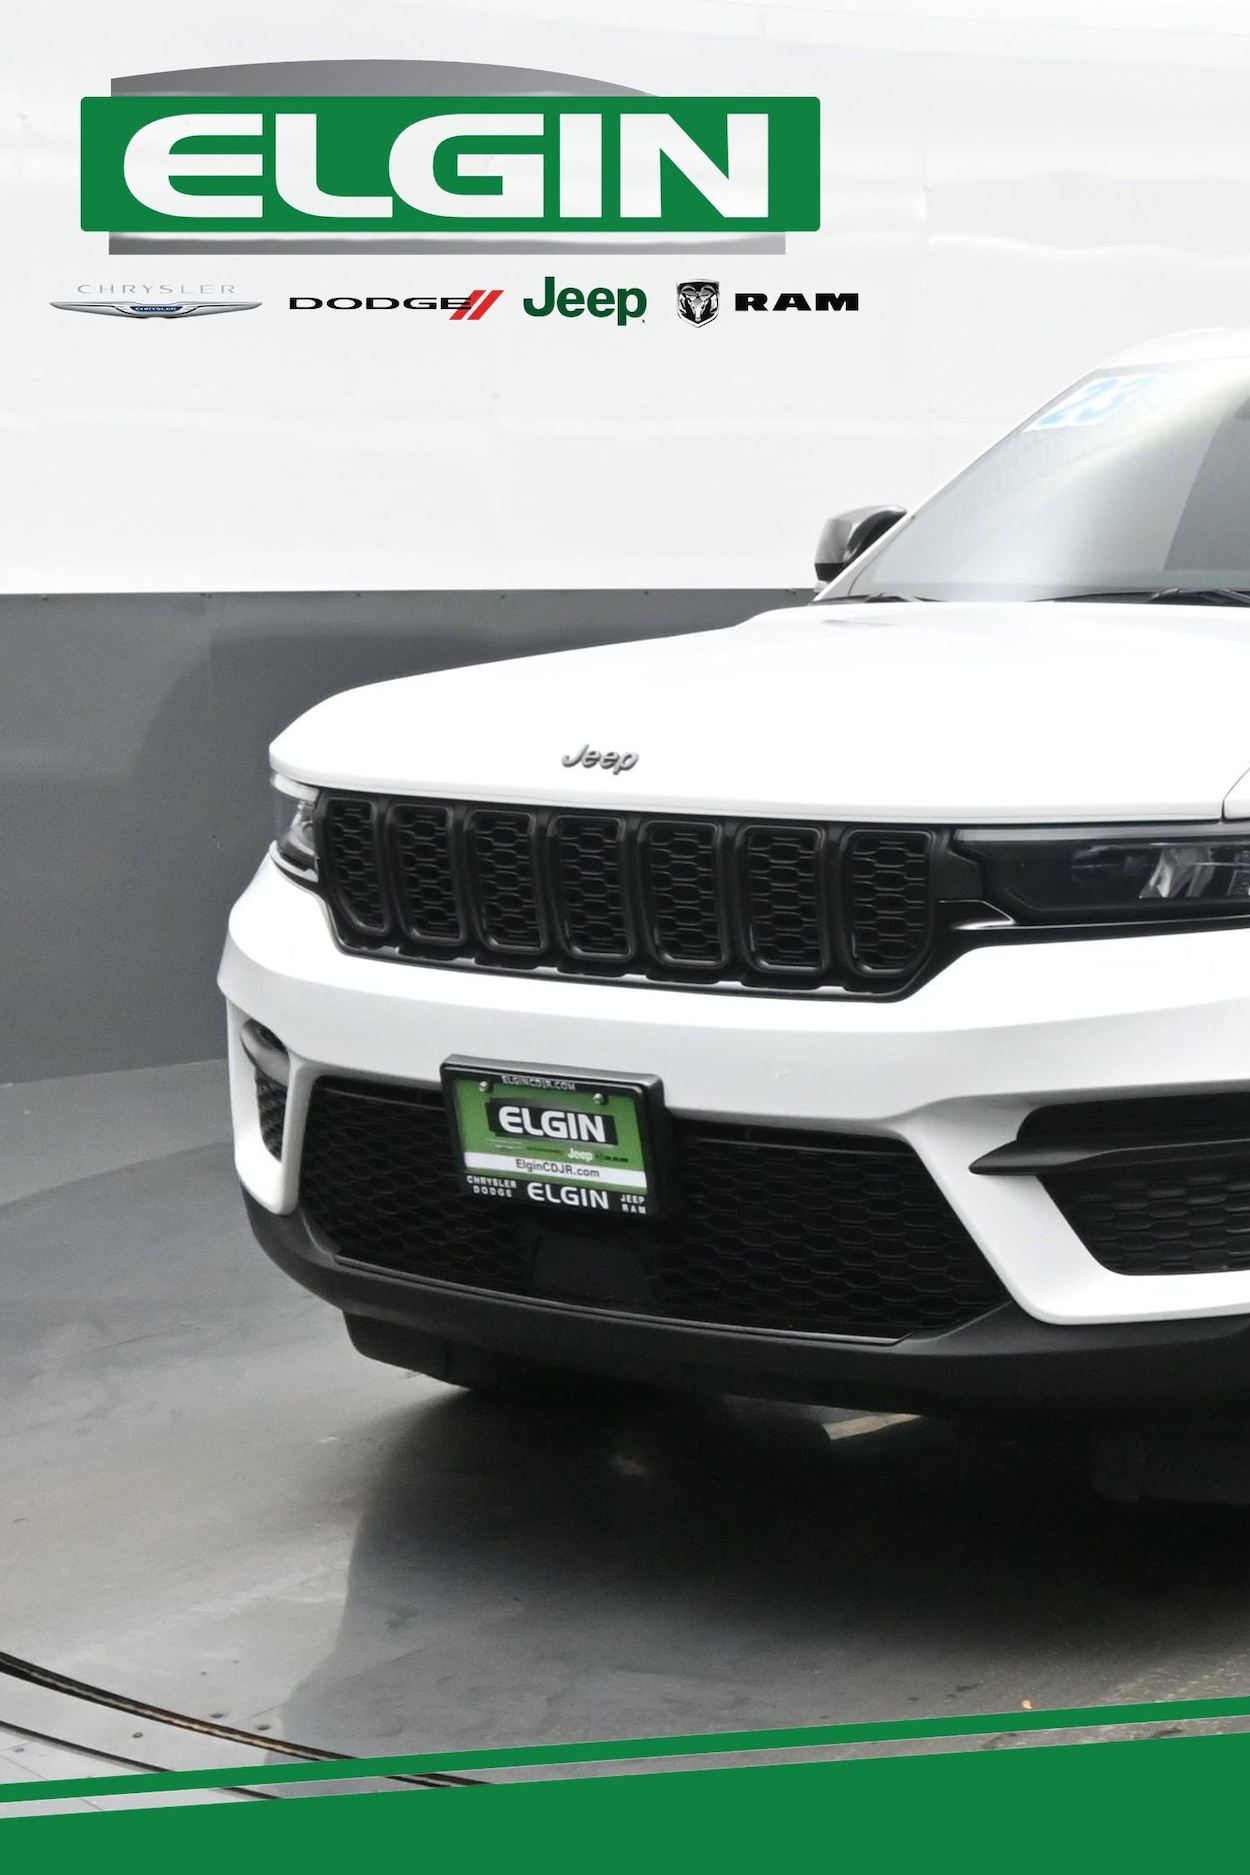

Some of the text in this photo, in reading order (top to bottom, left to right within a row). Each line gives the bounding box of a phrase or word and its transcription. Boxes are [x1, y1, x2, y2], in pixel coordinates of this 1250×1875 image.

[561, 743, 640, 776] Jeep
[501, 1074, 577, 1091] ELGINCDJR.COM
[498, 1105, 606, 1143] ELGIN
[567, 1147, 594, 1163] Jeep
[515, 1158, 600, 1178] ElginCDJR.com
[466, 1174, 517, 1189] CHRYSLER
[473, 1185, 512, 1198] DODGE
[527, 1181, 609, 1210] ELGIN
[620, 1194, 645, 1205] JEEP
[622, 1203, 647, 1215] RAM
